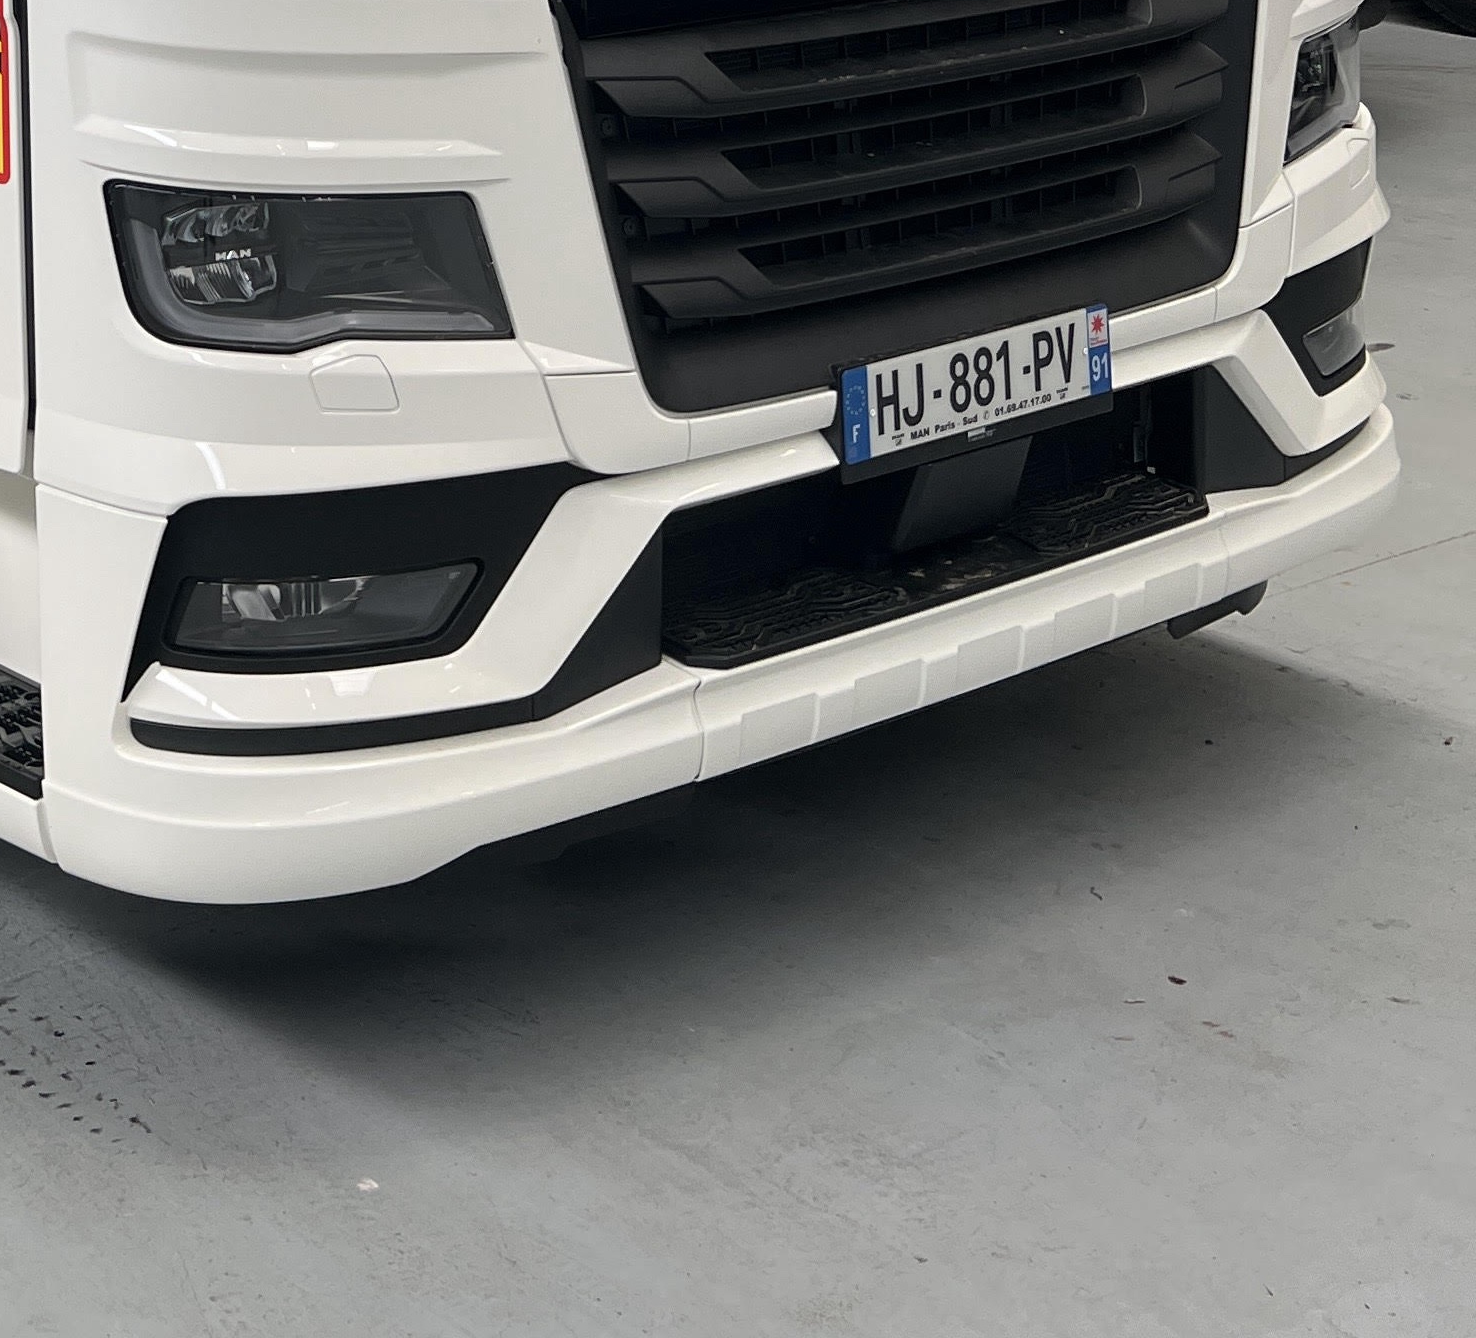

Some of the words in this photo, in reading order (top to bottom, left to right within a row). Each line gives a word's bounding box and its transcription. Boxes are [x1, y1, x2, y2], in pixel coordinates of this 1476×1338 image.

[215, 248, 252, 261] MAN
[1091, 354, 1110, 382] 91
[852, 424, 861, 444] F
[910, 427, 930, 440] MAN
[935, 421, 955, 433] Paris
